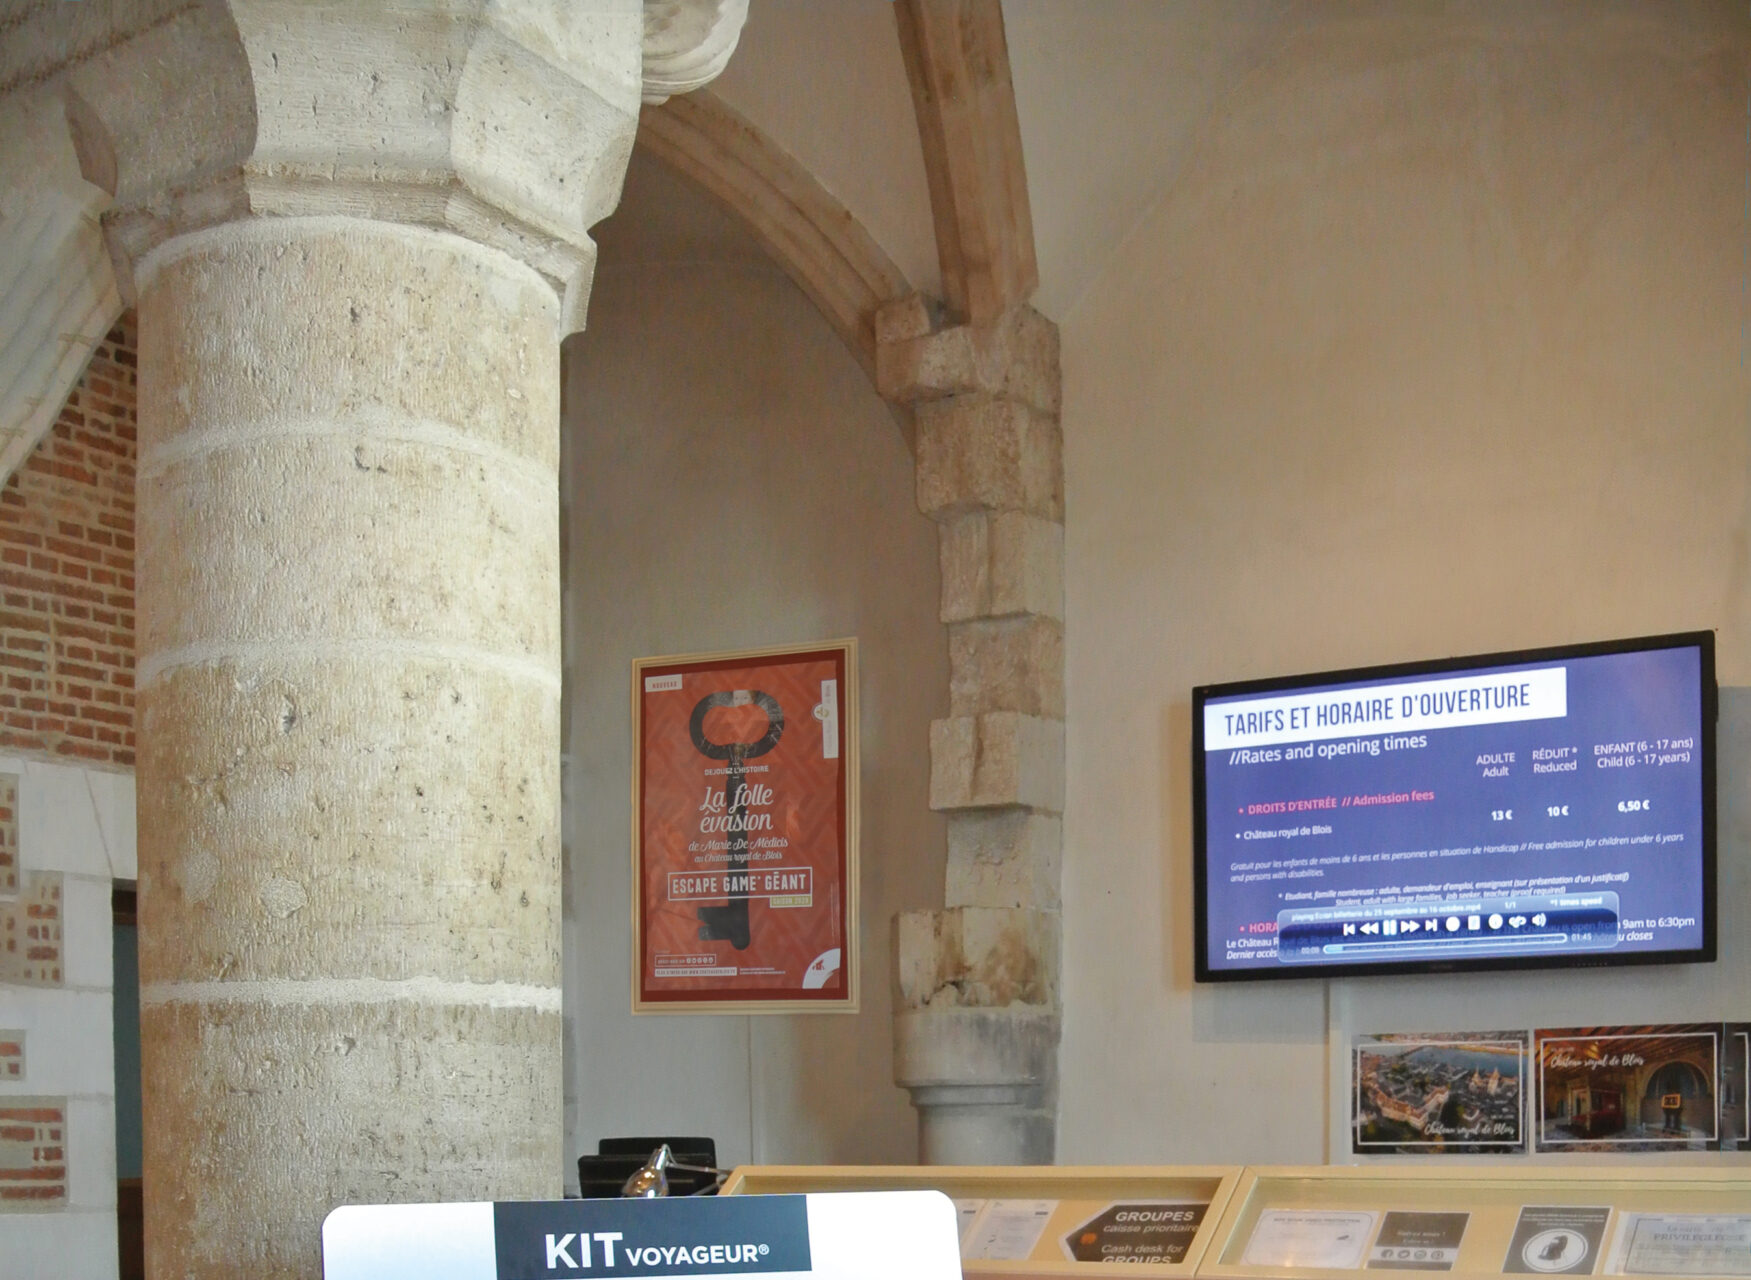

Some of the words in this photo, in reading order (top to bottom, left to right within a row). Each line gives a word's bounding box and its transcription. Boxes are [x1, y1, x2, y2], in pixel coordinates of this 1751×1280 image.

[1225, 709, 1284, 736] TARIFS
[1290, 707, 1311, 729] ET
[1317, 698, 1393, 727] HORAIRE
[1402, 684, 1530, 718] D'OUVERTURE
[1285, 744, 1313, 760] and
[1318, 739, 1380, 759] opening
[1384, 735, 1427, 751] times
[1532, 746, 1570, 760] RÉDUIT
[1594, 741, 1636, 755] ENFANT
[1637, 740, 1648, 753] (6
[1656, 739, 1669, 750] 17
[1671, 737, 1693, 750] ans)
[1476, 752, 1515, 766] ADULTE
[1597, 756, 1623, 769] Child
[1624, 755, 1636, 768] (6
[1644, 754, 1657, 765] 17
[1658, 751, 1690, 765] years)
[1482, 767, 1509, 778] Adult
[1533, 760, 1577, 774] Reduced
[699, 787, 727, 814] La
[729, 783, 774, 814] folle
[1248, 802, 1286, 815] DROITS
[1289, 797, 1337, 812] D'ENTRÉE
[1352, 791, 1409, 806] Admission
[1411, 790, 1435, 802] fees
[1547, 806, 1560, 817] 10
[1617, 801, 1641, 813] 6,50
[700, 810, 773, 833] évasion
[1491, 810, 1504, 821] 13
[1243, 827, 1277, 840] Château
[1279, 826, 1299, 839] royal
[1300, 826, 1311, 836] de
[1312, 825, 1332, 836] Blois
[688, 841, 699, 852] de
[701, 838, 732, 851] Marie
[733, 838, 749, 850] De
[750, 837, 788, 849] Médicis
[1528, 840, 1543, 850] Free
[1598, 835, 1629, 847] children
[1630, 834, 1653, 845] under
[1662, 833, 1684, 844] years
[694, 855, 704, 863] au
[734, 852, 752, 864] royal
[752, 852, 761, 860] de
[762, 850, 782, 861] Blois
[672, 877, 717, 894] ESCAPE
[765, 872, 806, 891] GÉANT
[1227, 940, 1236, 948] Le
[1238, 938, 1272, 948] Château
[1623, 919, 1644, 930] 9am
[1646, 918, 1656, 928] to
[1658, 917, 1695, 930] 6:30pm
[1227, 949, 1255, 960] Dernier
[1626, 931, 1653, 941] closes
[1115, 1211, 1195, 1222] GROUPES
[1103, 1225, 1141, 1233] caisse
[545, 1231, 623, 1269] KIT
[1101, 1244, 1133, 1254] Cash
[1135, 1244, 1163, 1254] desk
[1167, 1244, 1185, 1254] for
